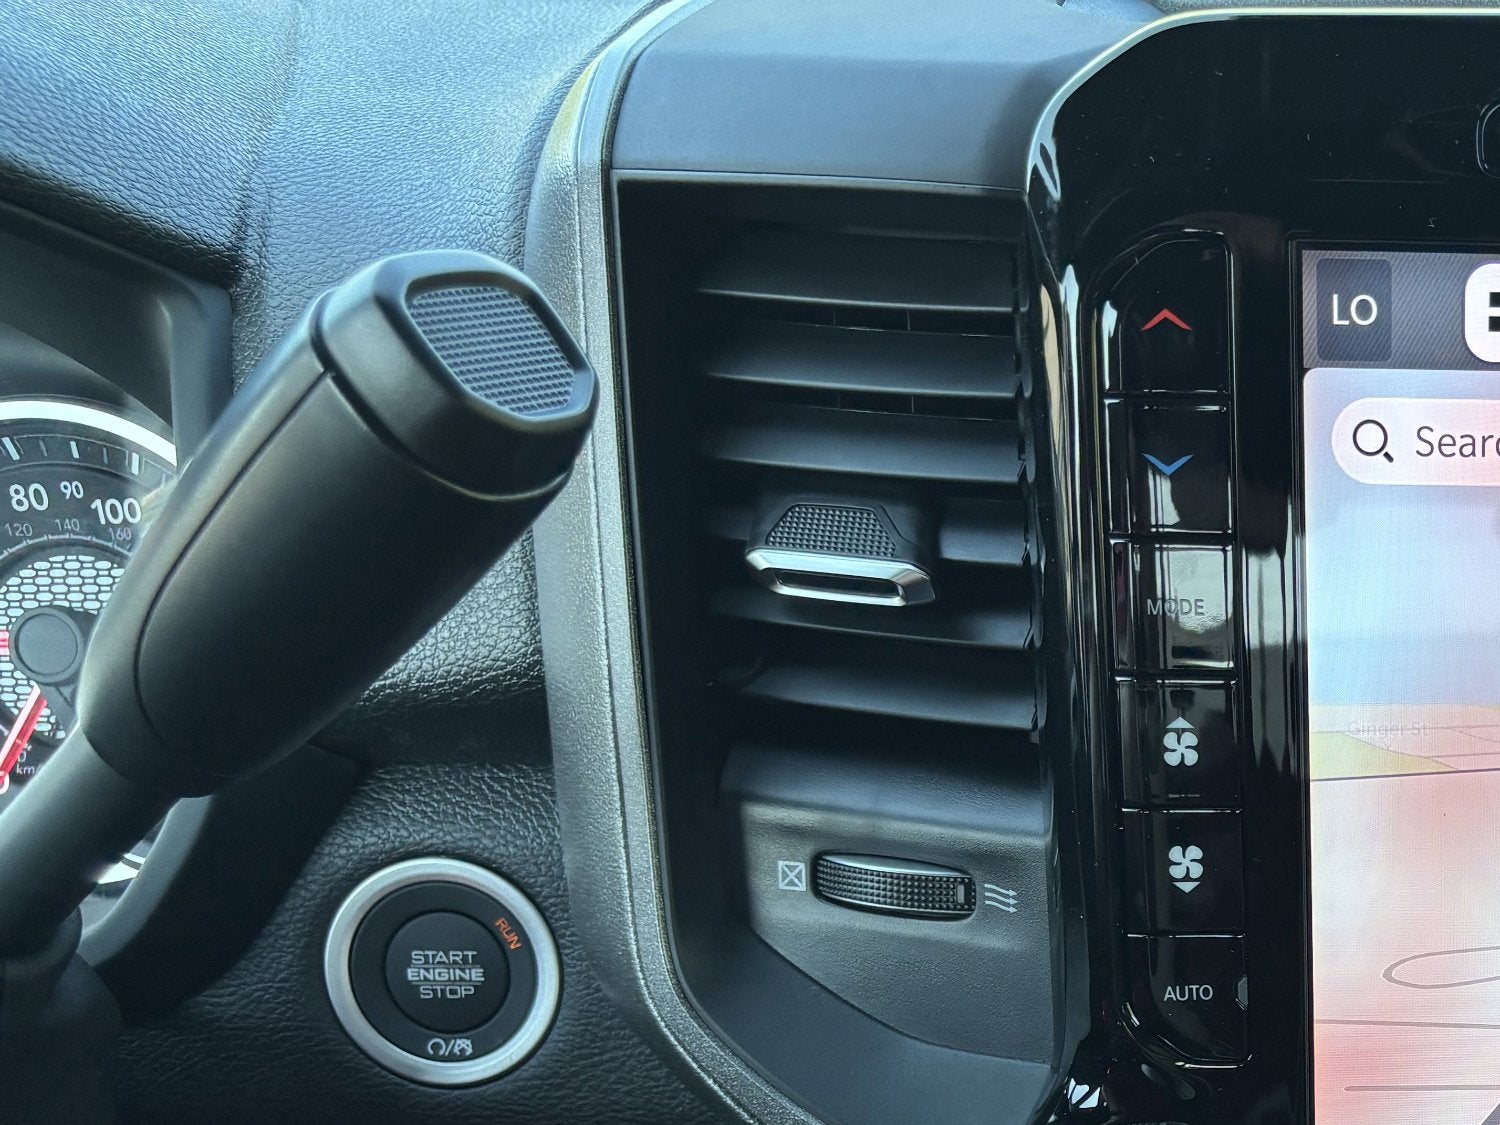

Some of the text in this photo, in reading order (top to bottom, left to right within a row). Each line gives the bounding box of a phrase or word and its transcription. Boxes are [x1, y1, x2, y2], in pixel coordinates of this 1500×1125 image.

[1332, 293, 1378, 326] LO
[9, 483, 49, 512] 80
[60, 480, 84, 500] 90
[90, 497, 142, 526] 100
[4, 523, 33, 537] 120
[54, 518, 80, 533] 140
[1146, 598, 1205, 617] MODE
[494, 917, 522, 951] RUN
[411, 950, 477, 965] START
[406, 967, 485, 982] ENGINE
[420, 985, 475, 999] STOP
[1163, 985, 1213, 1001] AUTO
